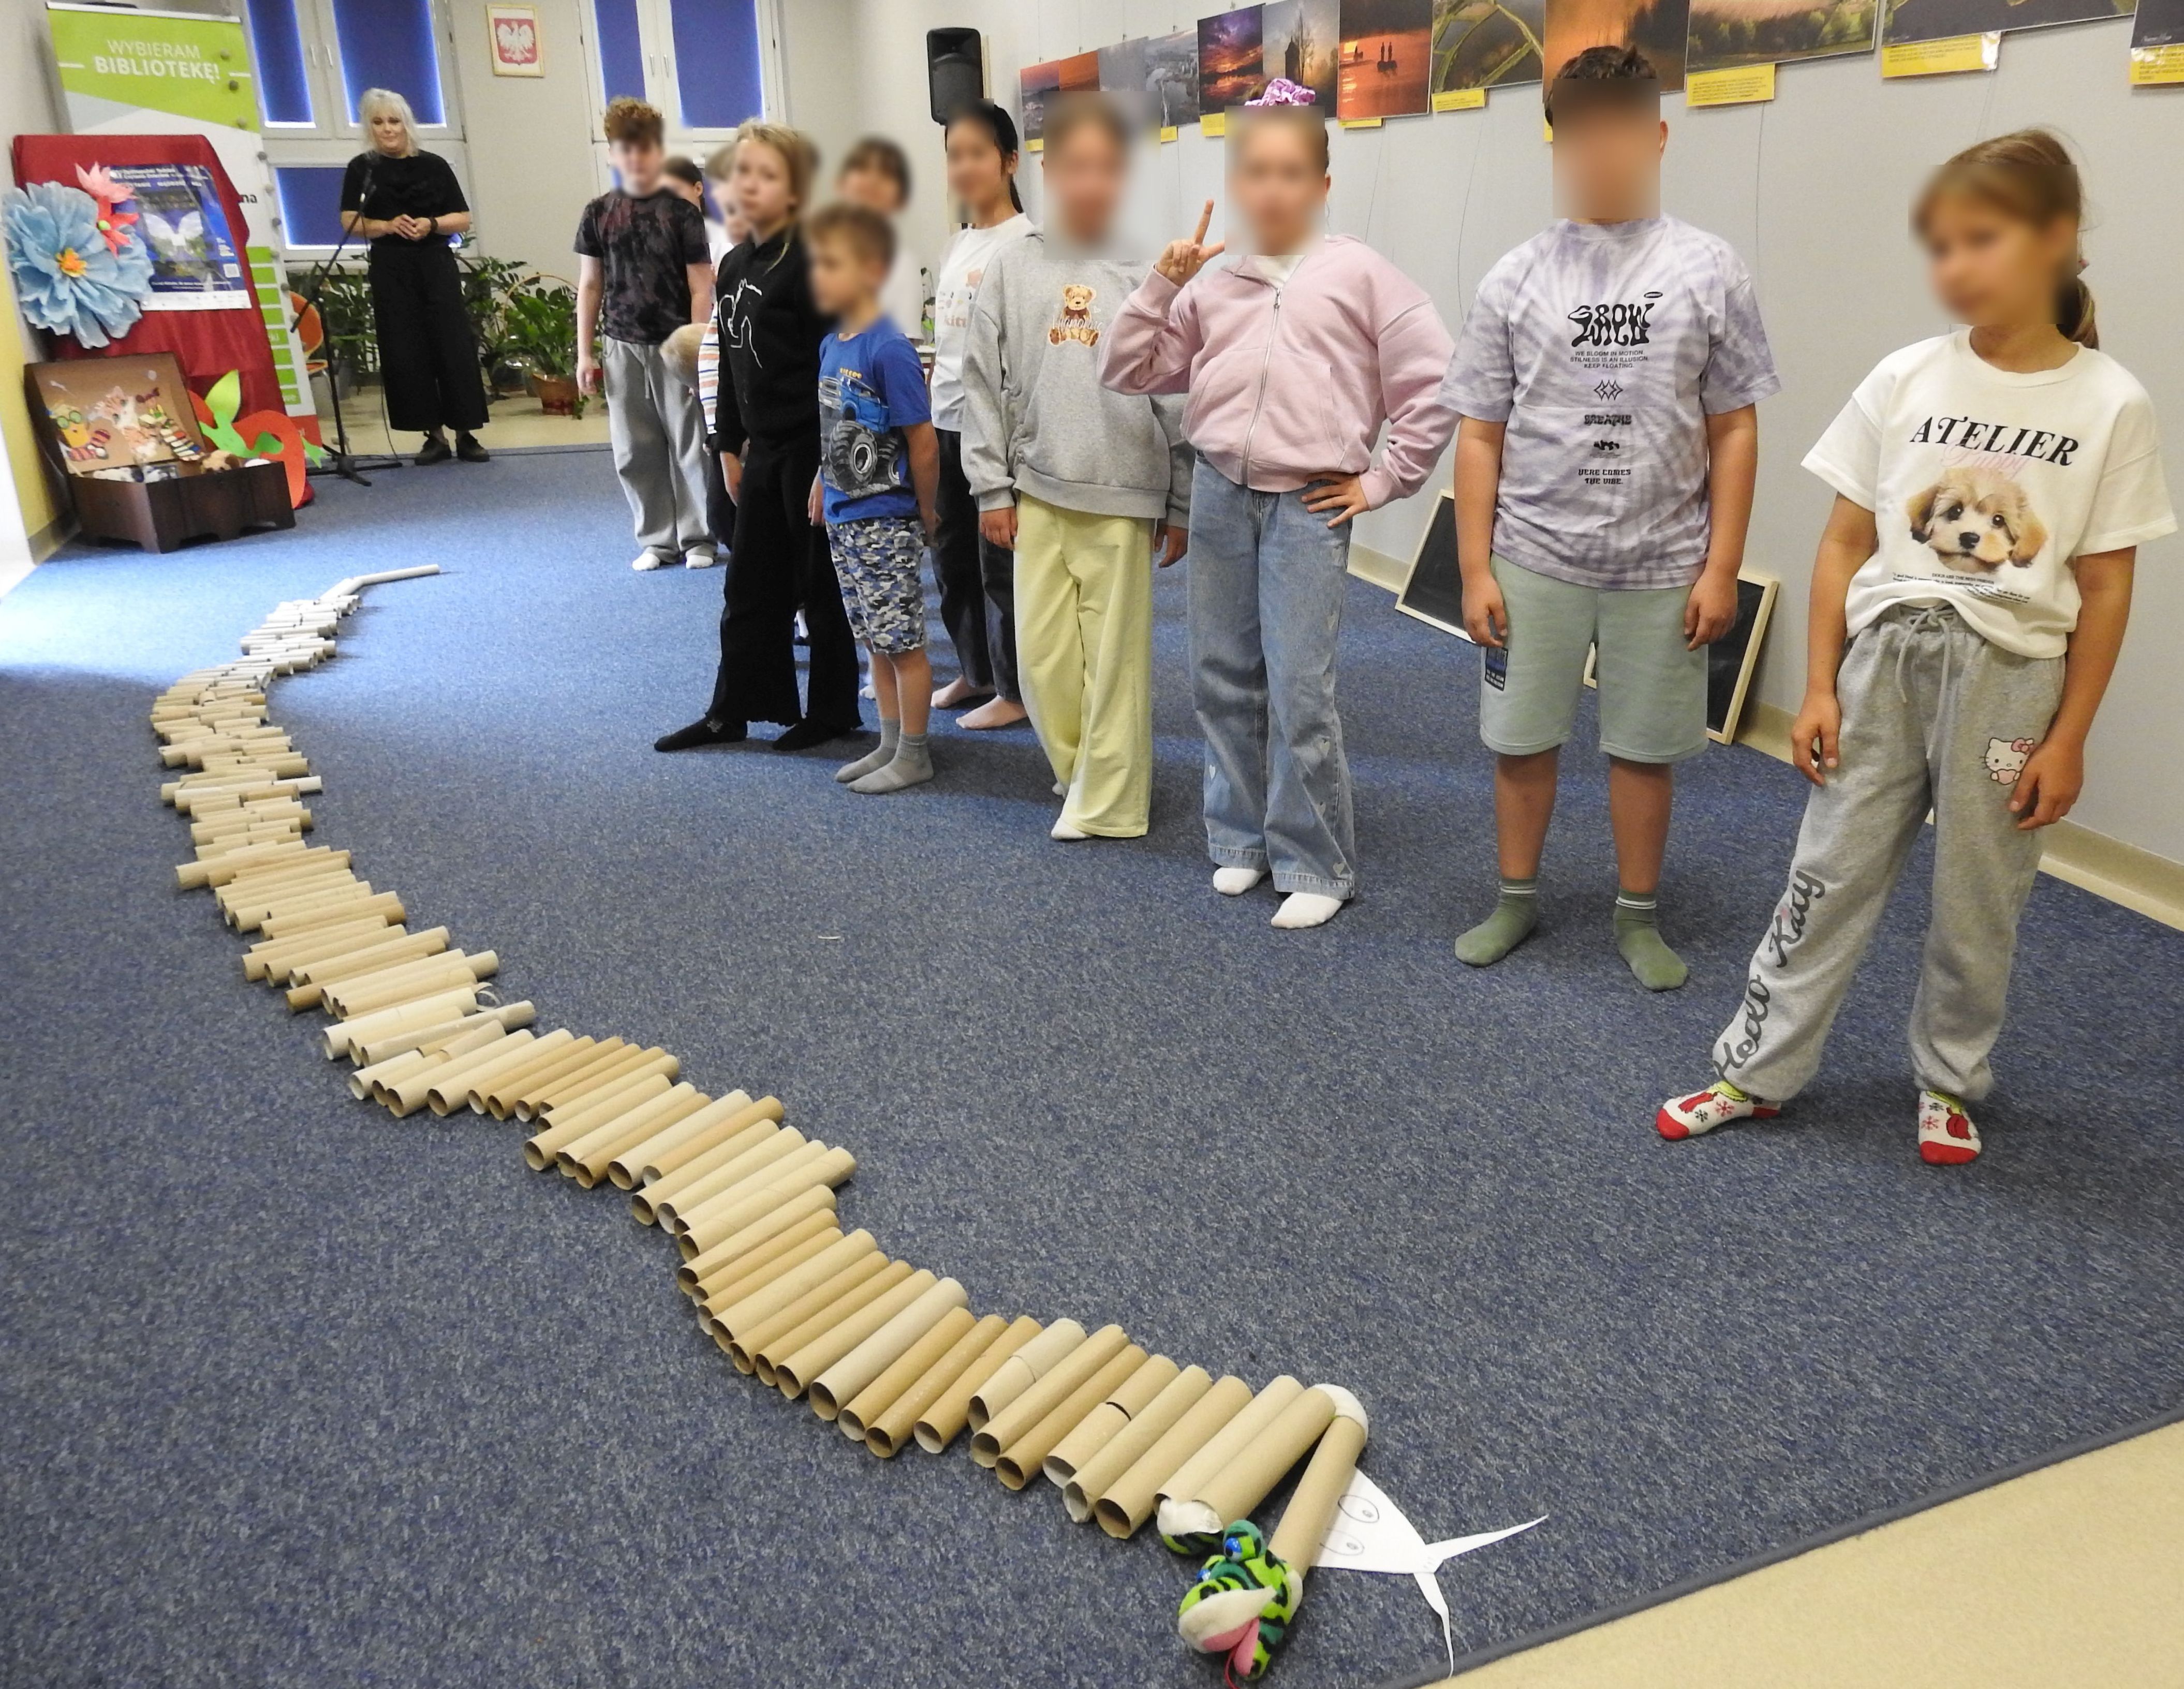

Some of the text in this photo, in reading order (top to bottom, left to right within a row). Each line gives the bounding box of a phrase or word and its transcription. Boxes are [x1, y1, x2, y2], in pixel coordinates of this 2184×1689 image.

[107, 40, 200, 59] WYBIERAM
[94, 56, 220, 85] BIBLIOTEKĘ!
[1909, 416, 2079, 466] ATELIER
